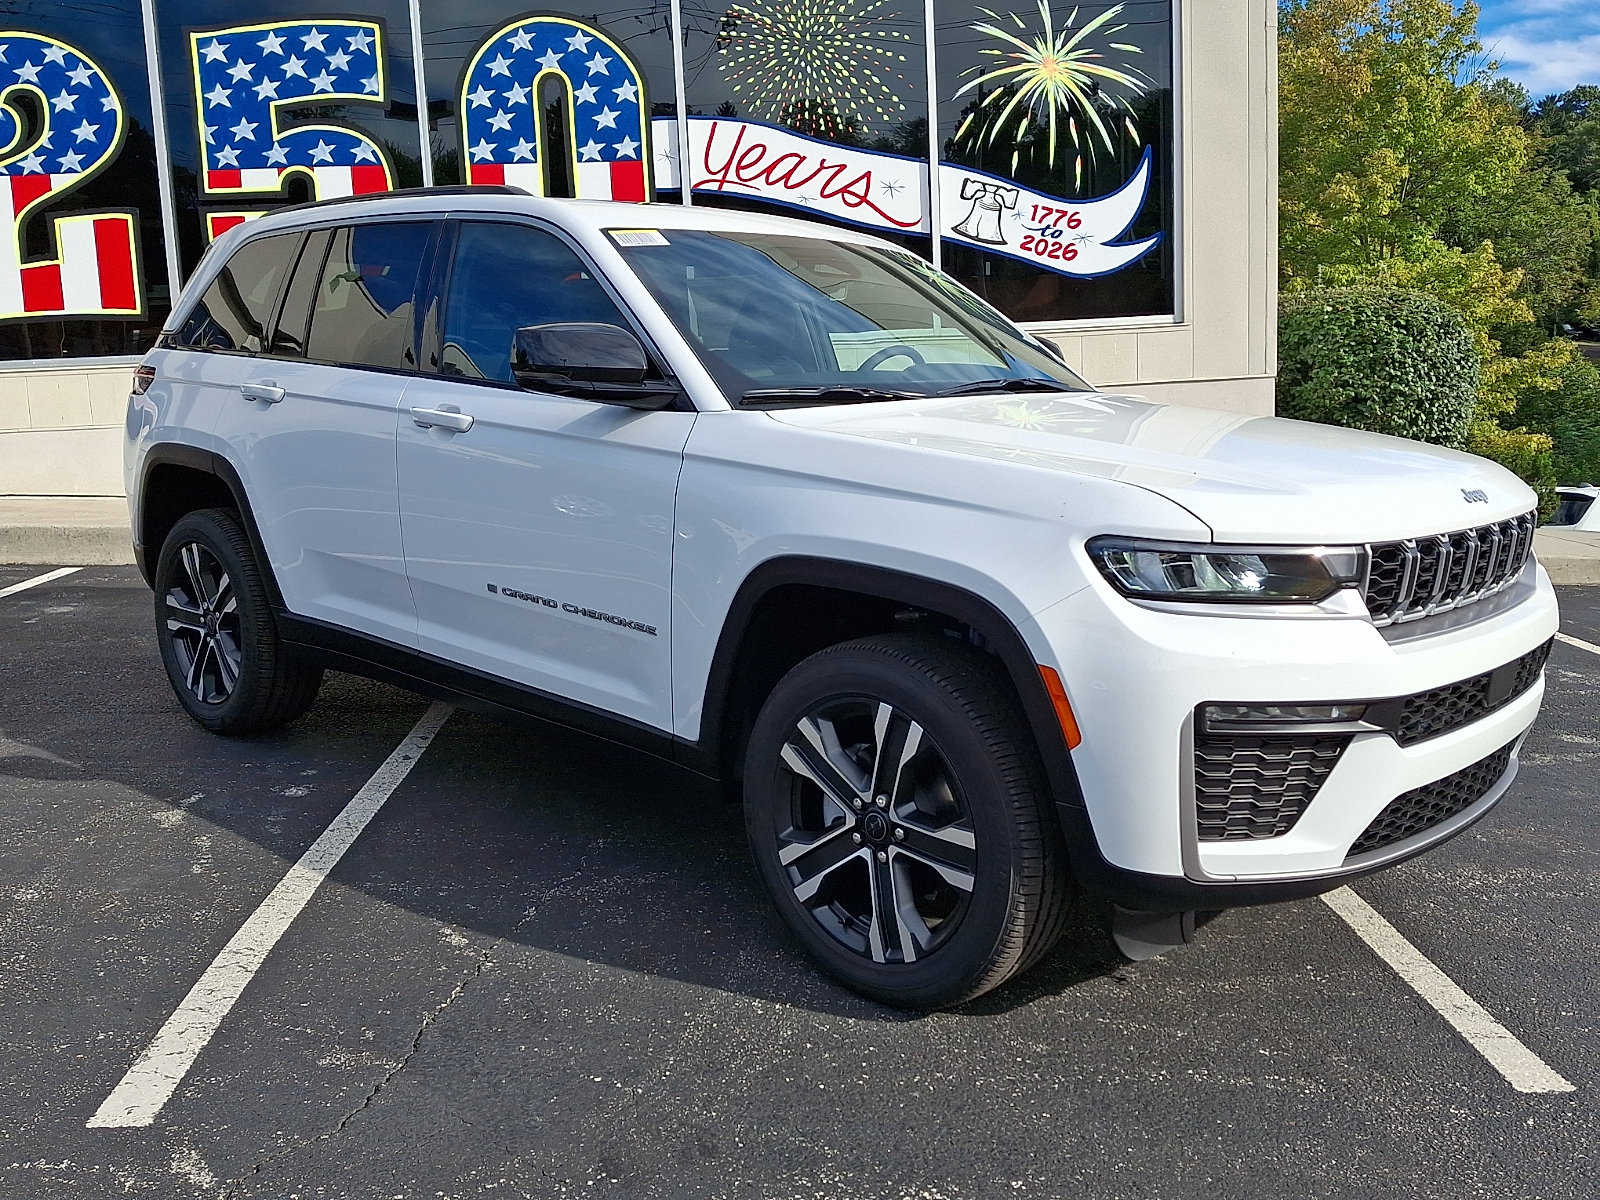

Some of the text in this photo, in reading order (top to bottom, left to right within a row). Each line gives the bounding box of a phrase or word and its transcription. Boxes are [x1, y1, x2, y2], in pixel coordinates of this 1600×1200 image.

[692, 121, 923, 227] Years
[1031, 204, 1082, 229] 1776
[1022, 224, 1064, 239] to
[1020, 235, 1078, 261] 2026
[1460, 488, 1488, 504] Jeep
[501, 586, 657, 636] GRAND CHEROKEE
